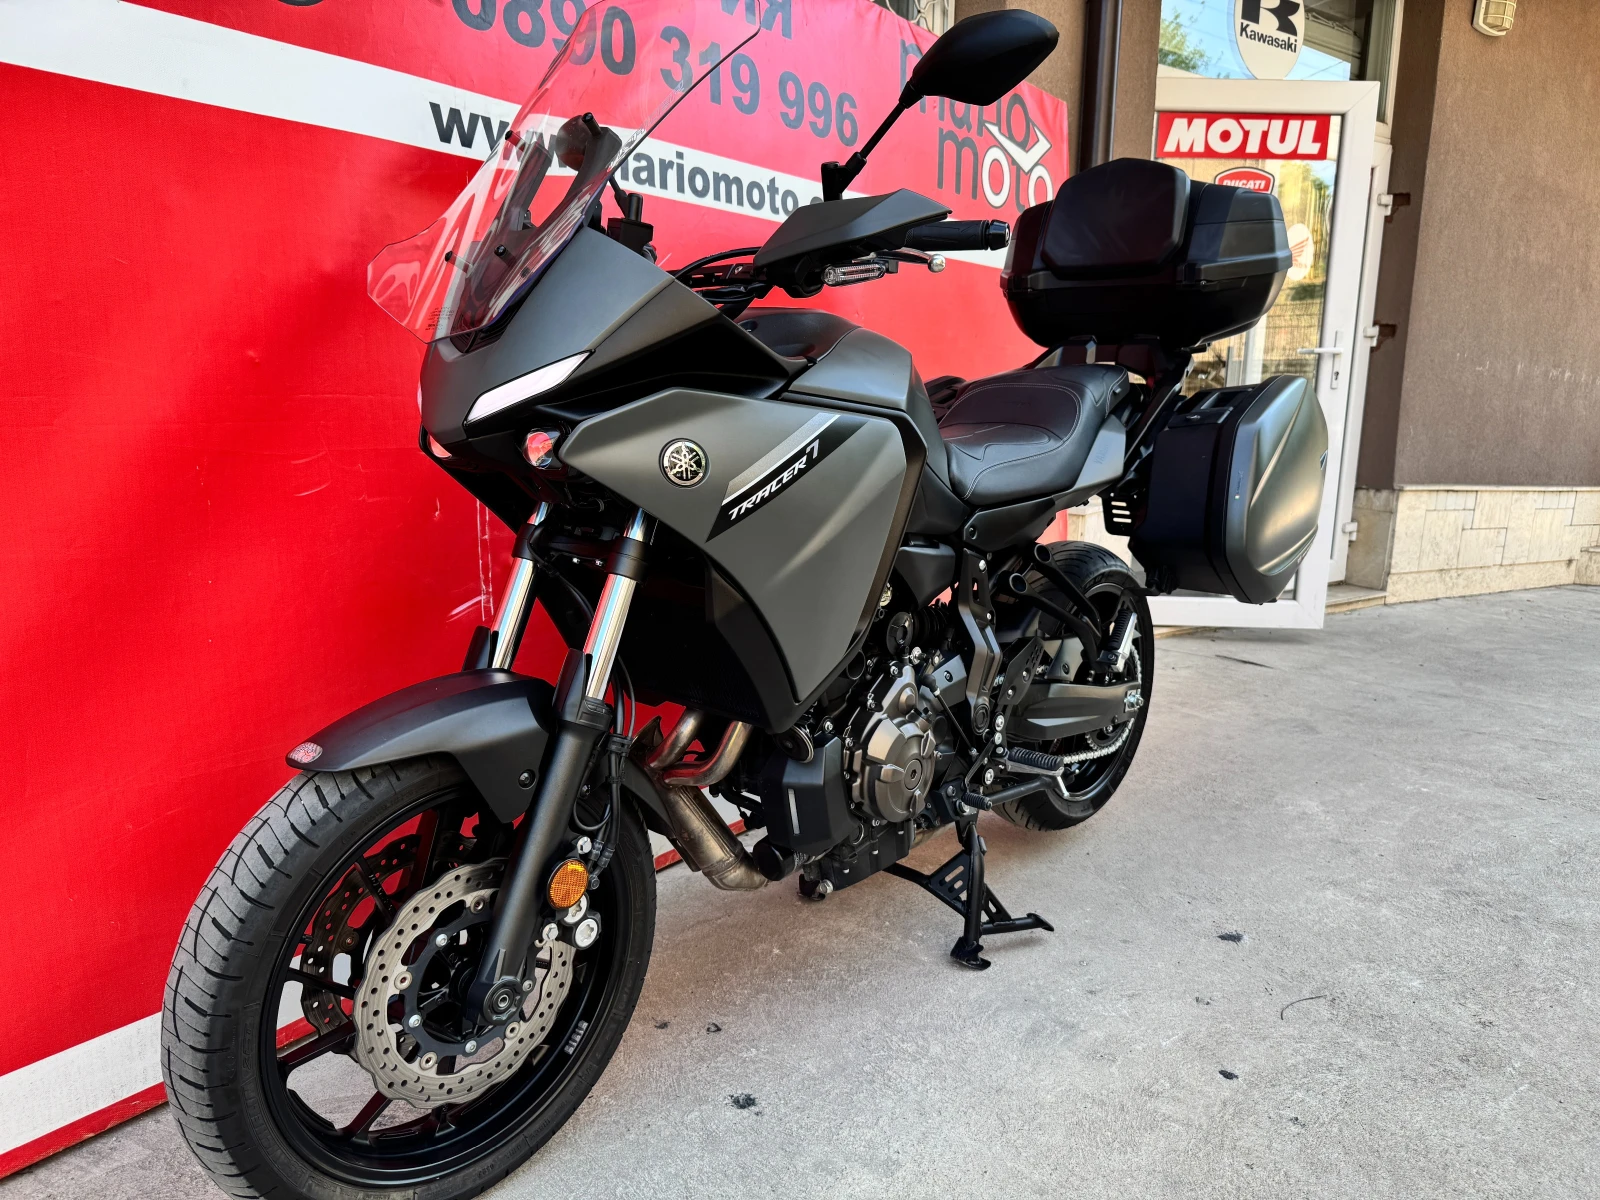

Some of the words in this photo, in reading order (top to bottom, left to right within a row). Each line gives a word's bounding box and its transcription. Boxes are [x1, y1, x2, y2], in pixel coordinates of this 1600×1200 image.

[1239, 21, 1298, 53] Kawasaki
[659, 25, 760, 115] 319
[778, 70, 859, 147] 996
[1163, 117, 1322, 155] MOTUL
[728, 455, 807, 521] TRACER
[806, 438, 820, 460] 7
